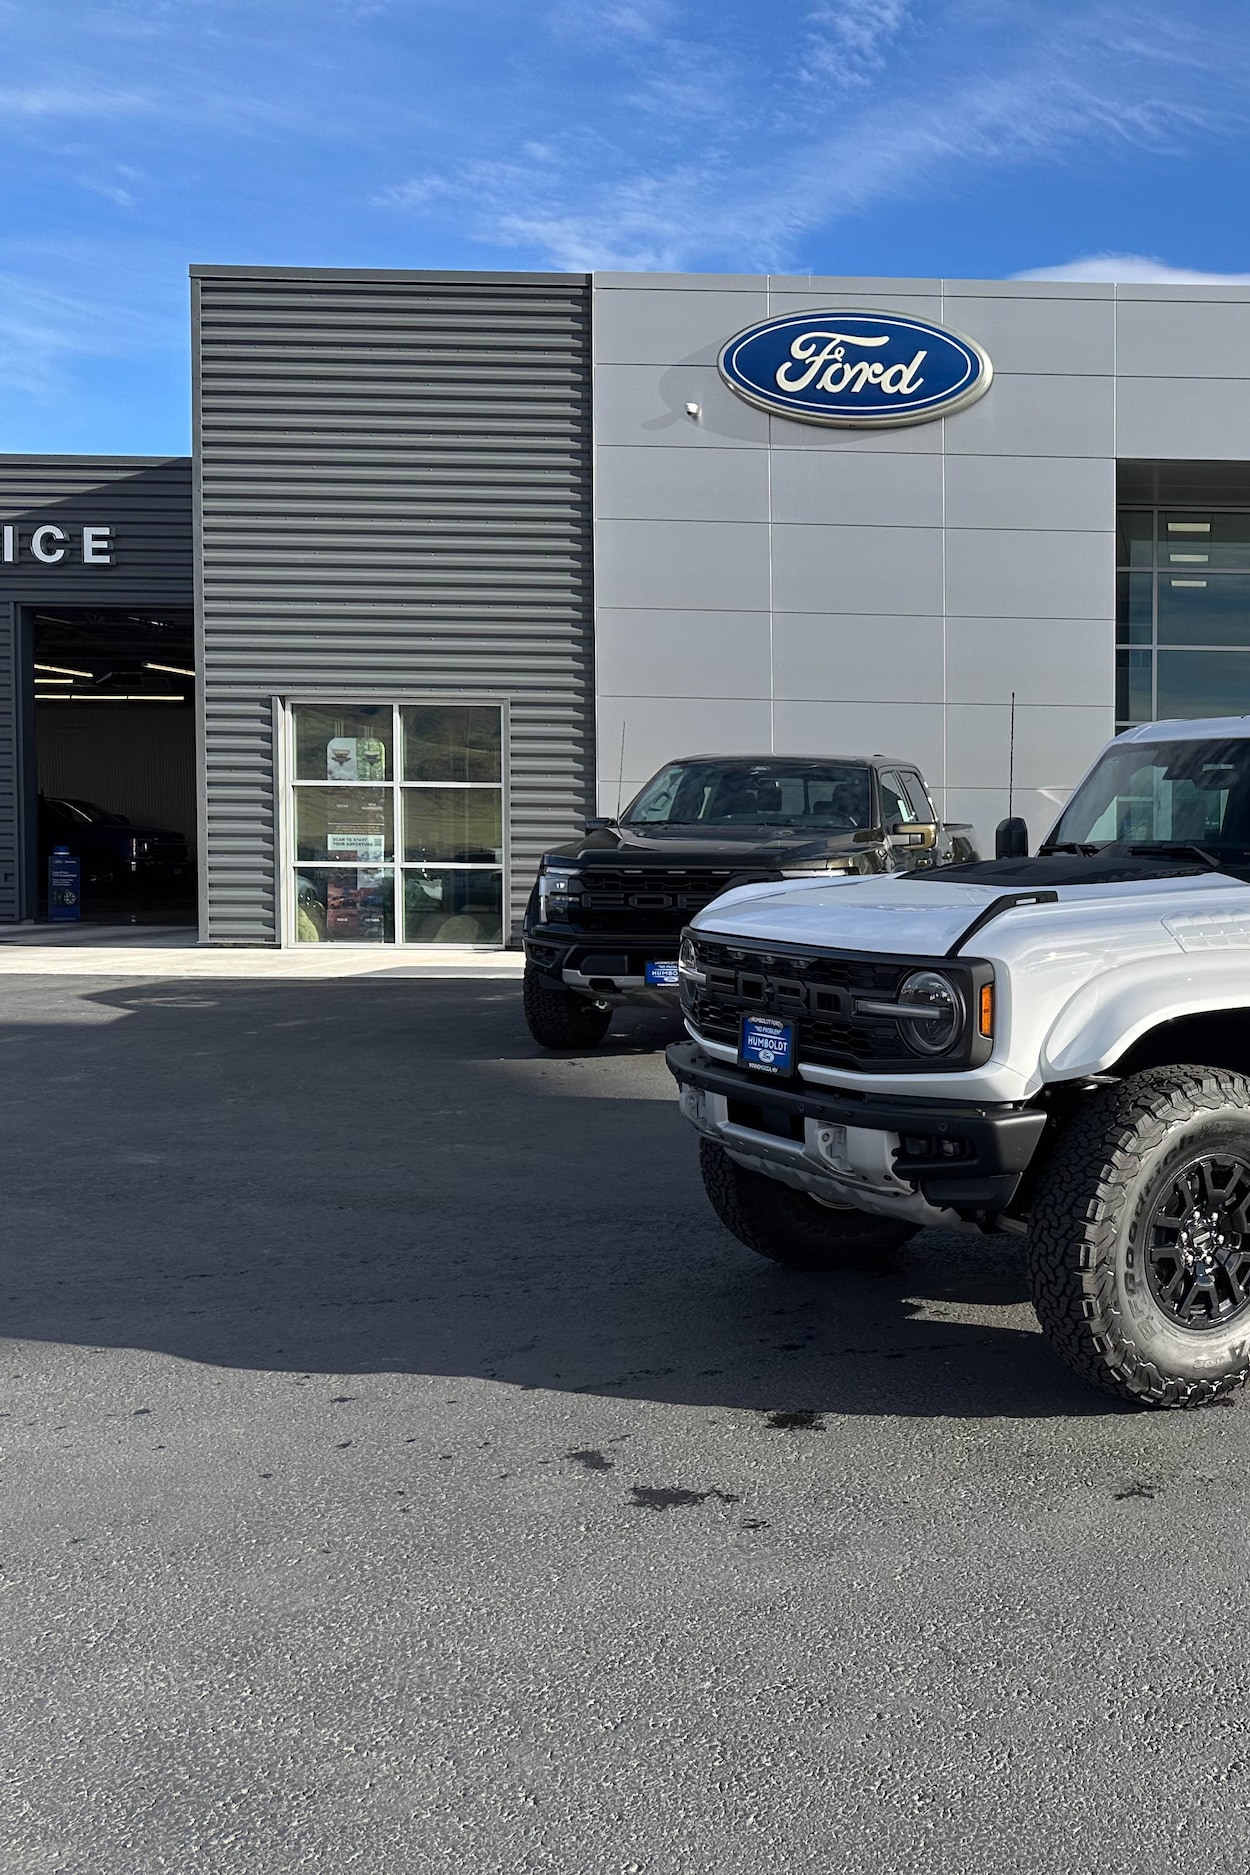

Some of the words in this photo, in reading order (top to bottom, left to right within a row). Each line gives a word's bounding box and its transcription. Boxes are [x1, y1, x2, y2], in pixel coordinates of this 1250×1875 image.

[776, 331, 928, 395] Ford
[707, 966, 851, 1022] FORD
[748, 1036, 788, 1051] HUMBOLDT
